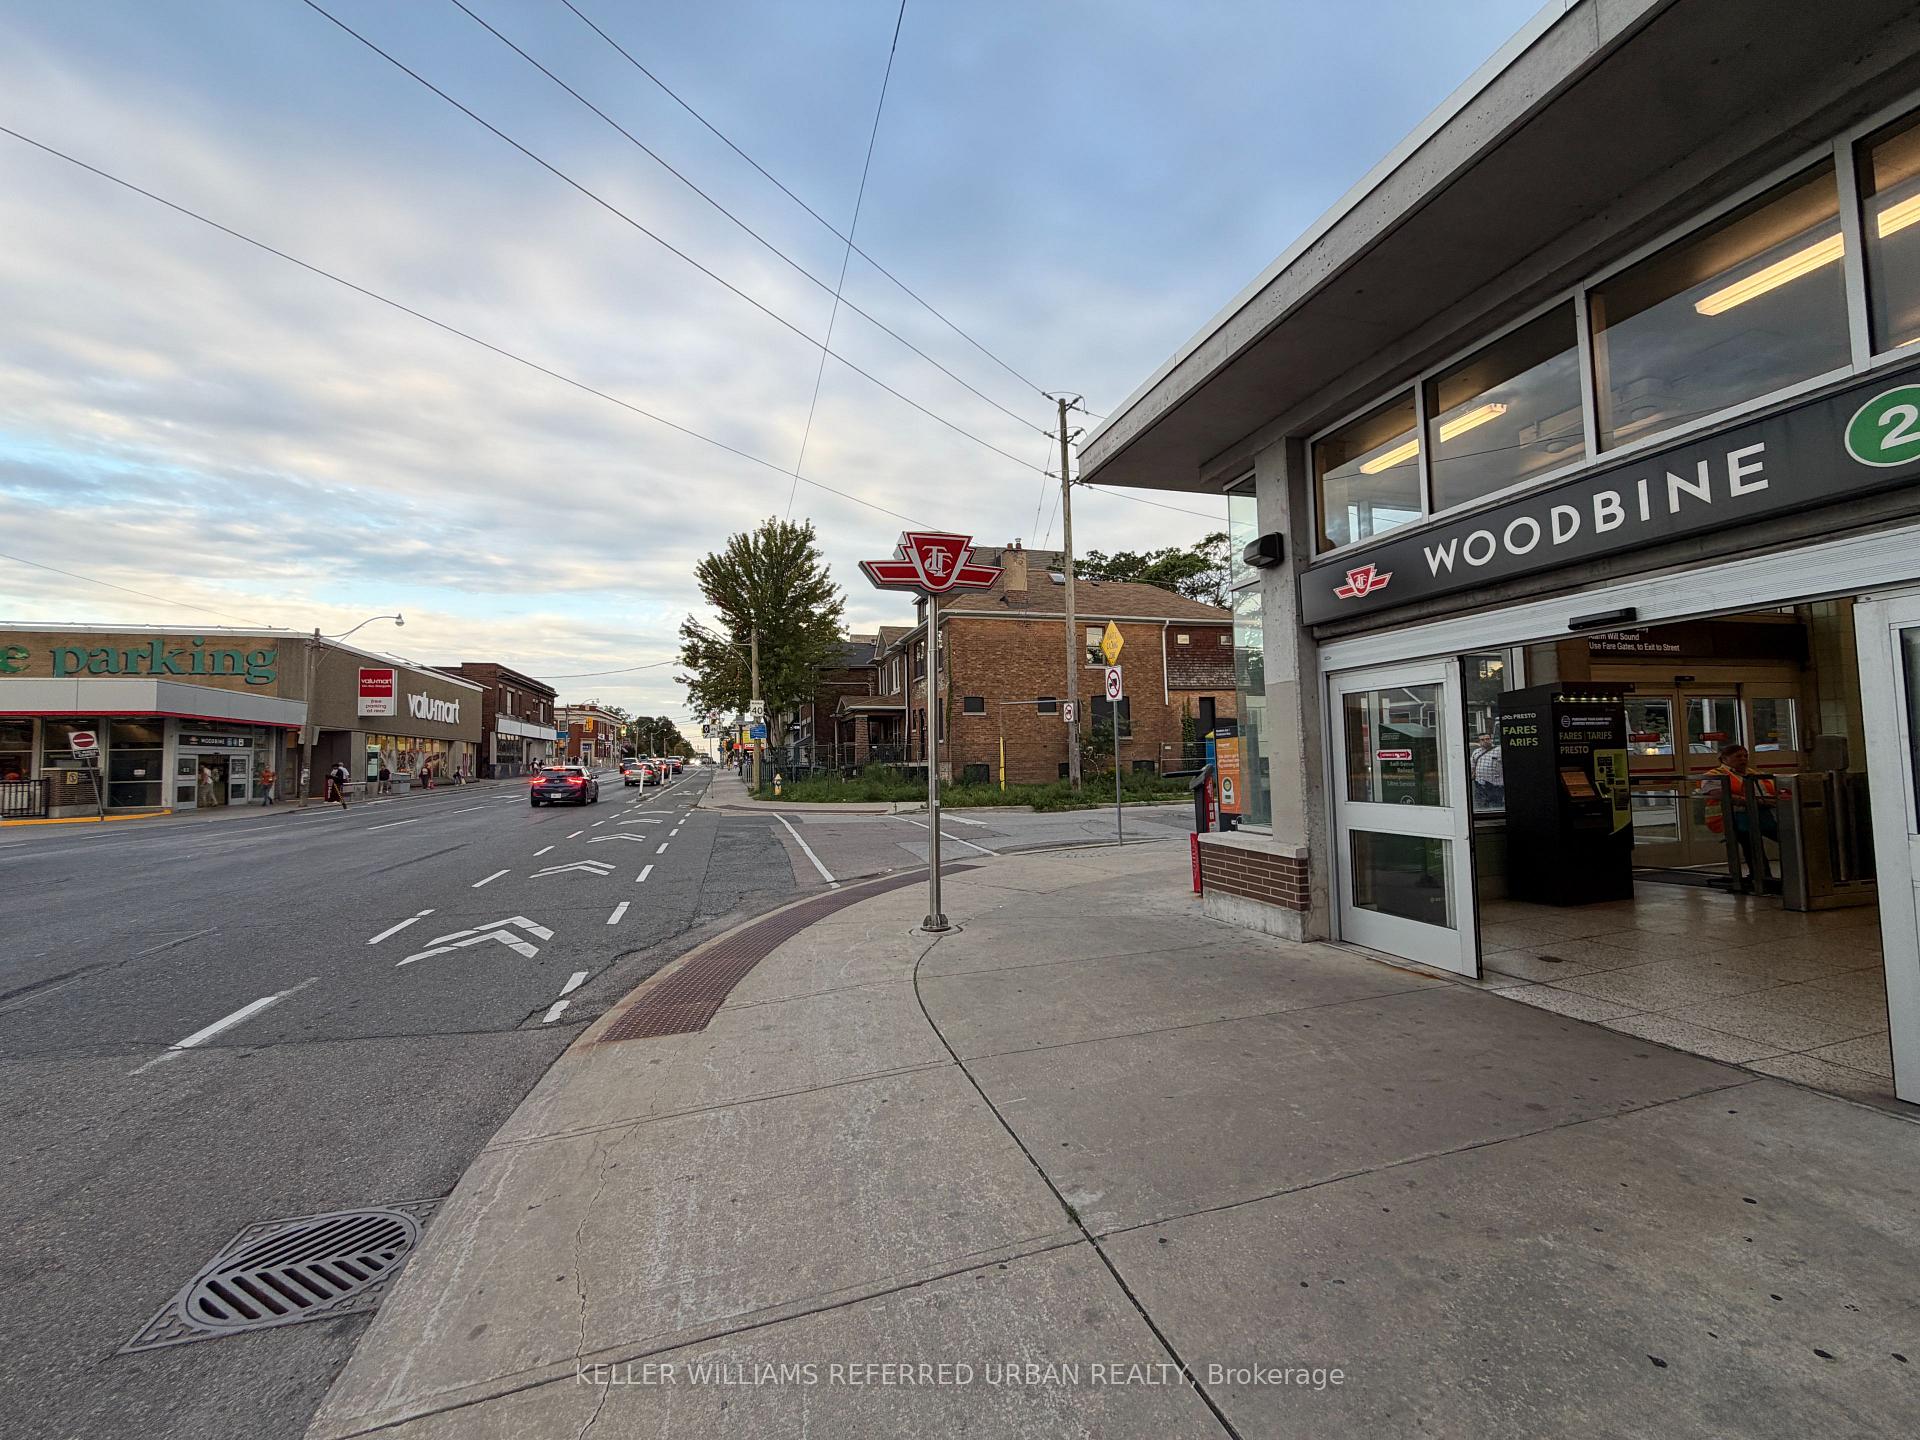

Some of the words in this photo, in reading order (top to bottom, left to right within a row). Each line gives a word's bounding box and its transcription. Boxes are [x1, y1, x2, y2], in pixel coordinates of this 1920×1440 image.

[1878, 404, 1920, 451] 2
[1424, 442, 1769, 578] WOODBINE
[1607, 632, 1619, 640] Will
[1620, 633, 1640, 641] Sound
[1589, 642, 1601, 650] Use
[1602, 642, 1616, 650] Fare
[1644, 643, 1655, 651] Exit
[1663, 644, 1680, 652] Street
[51, 636, 278, 685] parking
[751, 707, 763, 715] 40
[1502, 725, 1538, 735] FARES
[1559, 731, 1583, 740] FARES
[1587, 731, 1613, 740] TARIFS
[1560, 745, 1589, 754] PRESTO
